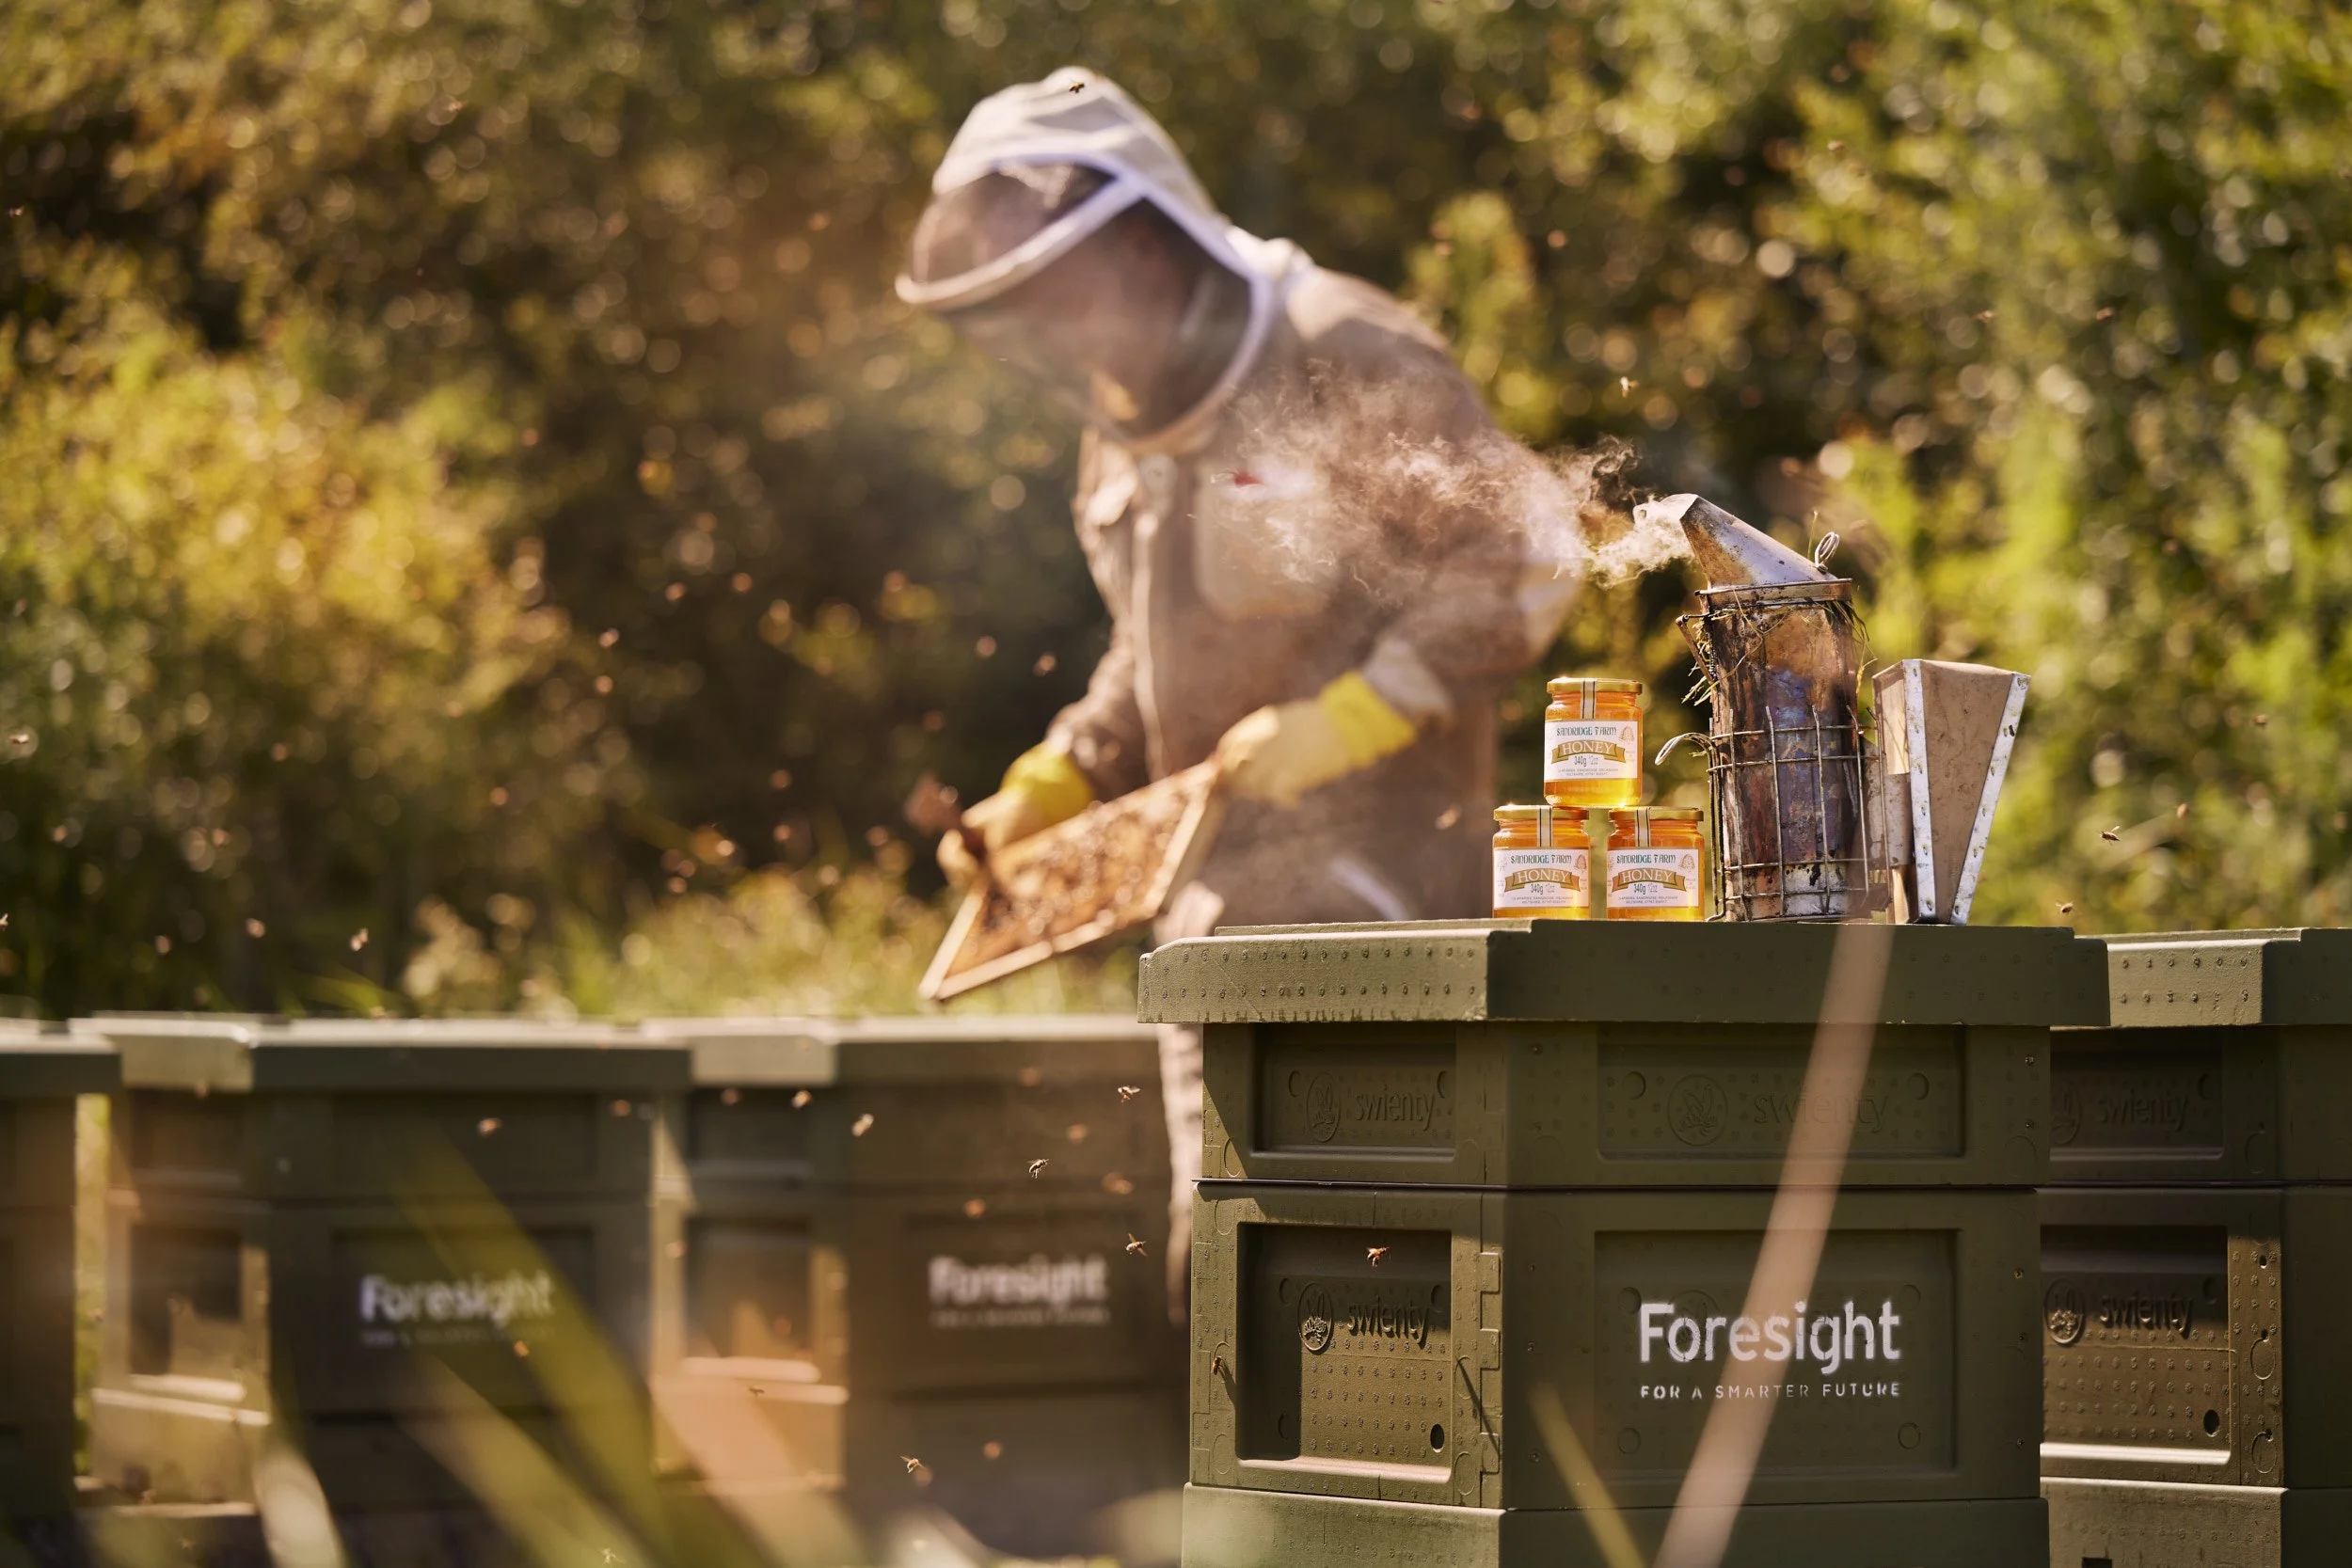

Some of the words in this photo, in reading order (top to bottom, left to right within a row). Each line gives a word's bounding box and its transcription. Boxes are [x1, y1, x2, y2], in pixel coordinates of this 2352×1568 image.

[1556, 726, 1593, 736] SANDRIDGE
[1595, 726, 1616, 736] FARM
[1562, 740, 1613, 755] HONEY
[1574, 755, 1587, 767] 340g
[1510, 854, 1549, 864] SANDRIDGE
[1551, 854, 1572, 863] FARM
[1616, 854, 1652, 864] SANDRIDGE
[1653, 854, 1676, 863] FARM
[1517, 869, 1569, 883] HONEY
[1622, 869, 1673, 883] HONEY
[1530, 884, 1544, 895] 340g
[1633, 883, 1646, 895] 340g
[1355, 1084, 1436, 1131] swienty
[1347, 1294, 1430, 1346] swienty
[2100, 1289, 2194, 1337] swienty
[1640, 1301, 1900, 1374] Foresight
[1640, 1385, 1680, 1400] FOR
[1691, 1386, 1703, 1400] A
[1714, 1384, 1809, 1399] SMARTER
[1821, 1382, 1900, 1398] FUTURE
